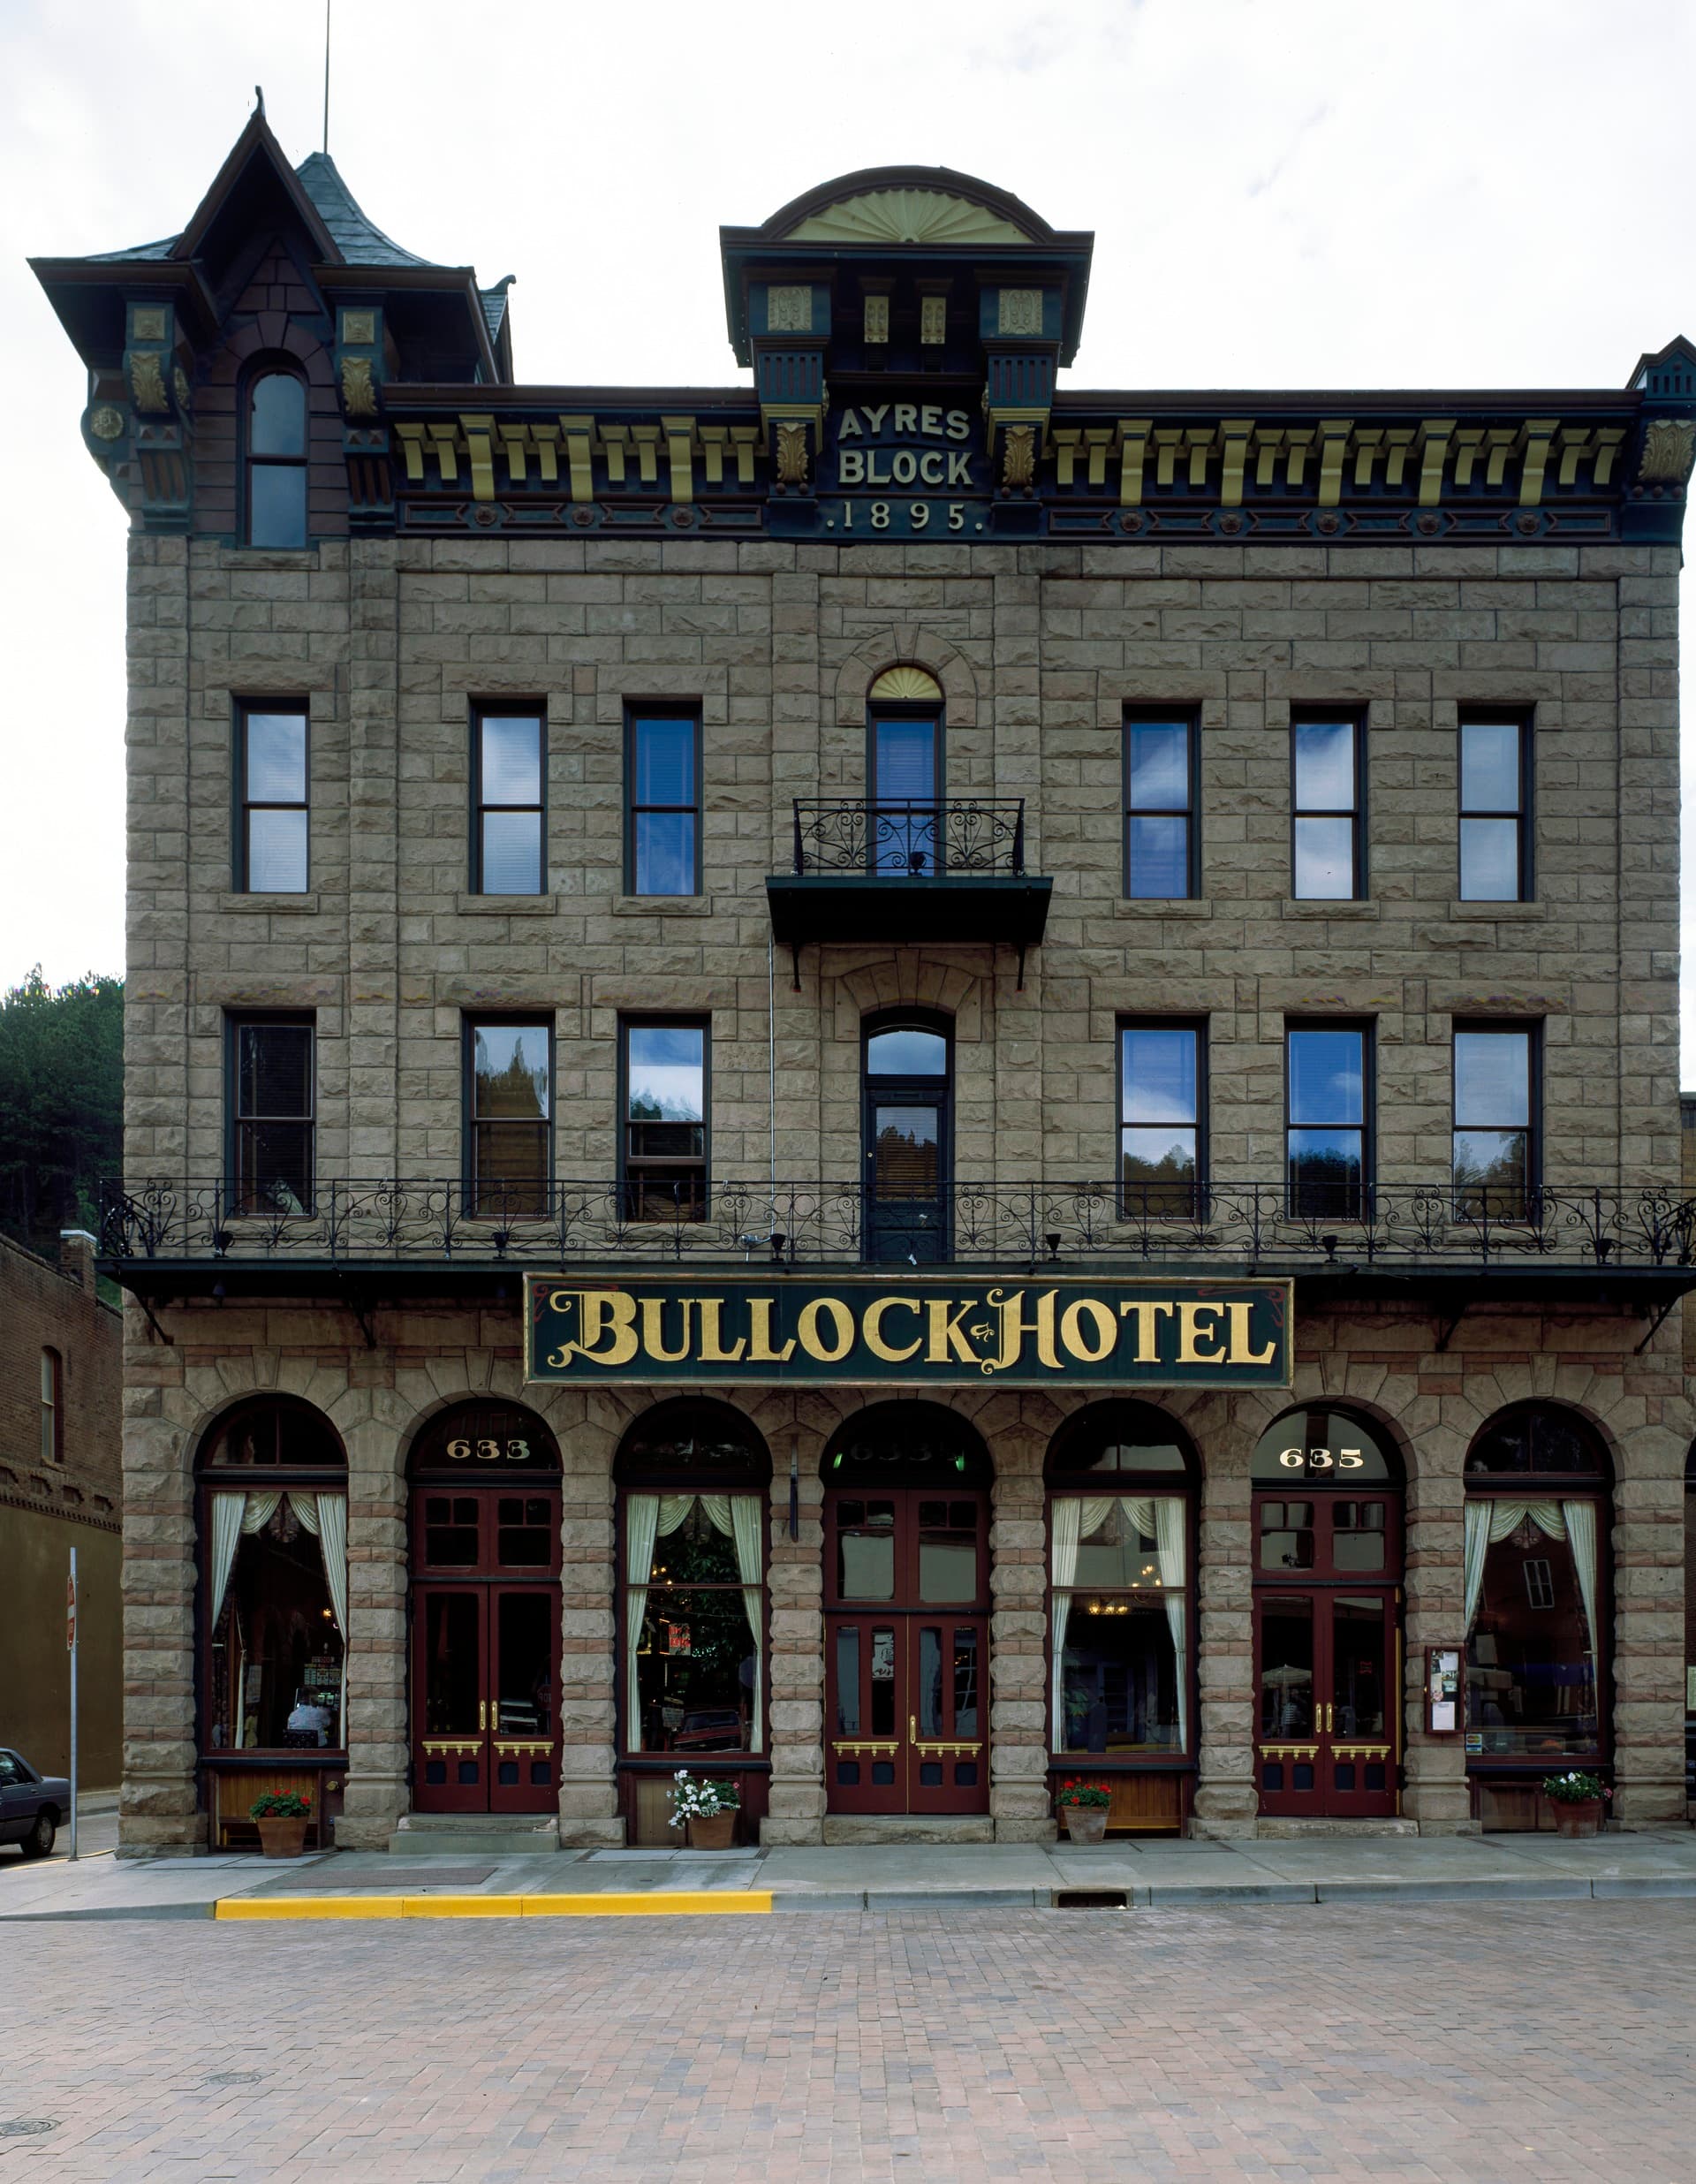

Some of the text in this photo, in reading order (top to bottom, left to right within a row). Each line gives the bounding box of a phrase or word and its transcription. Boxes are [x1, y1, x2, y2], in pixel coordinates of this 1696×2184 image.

[837, 404, 970, 440] AYRES
[838, 451, 973, 484] BLOCK
[547, 1288, 1276, 1375] BULLOCK HOTEL
[446, 1439, 530, 1459] 633
[1279, 1448, 1364, 1468] 635
